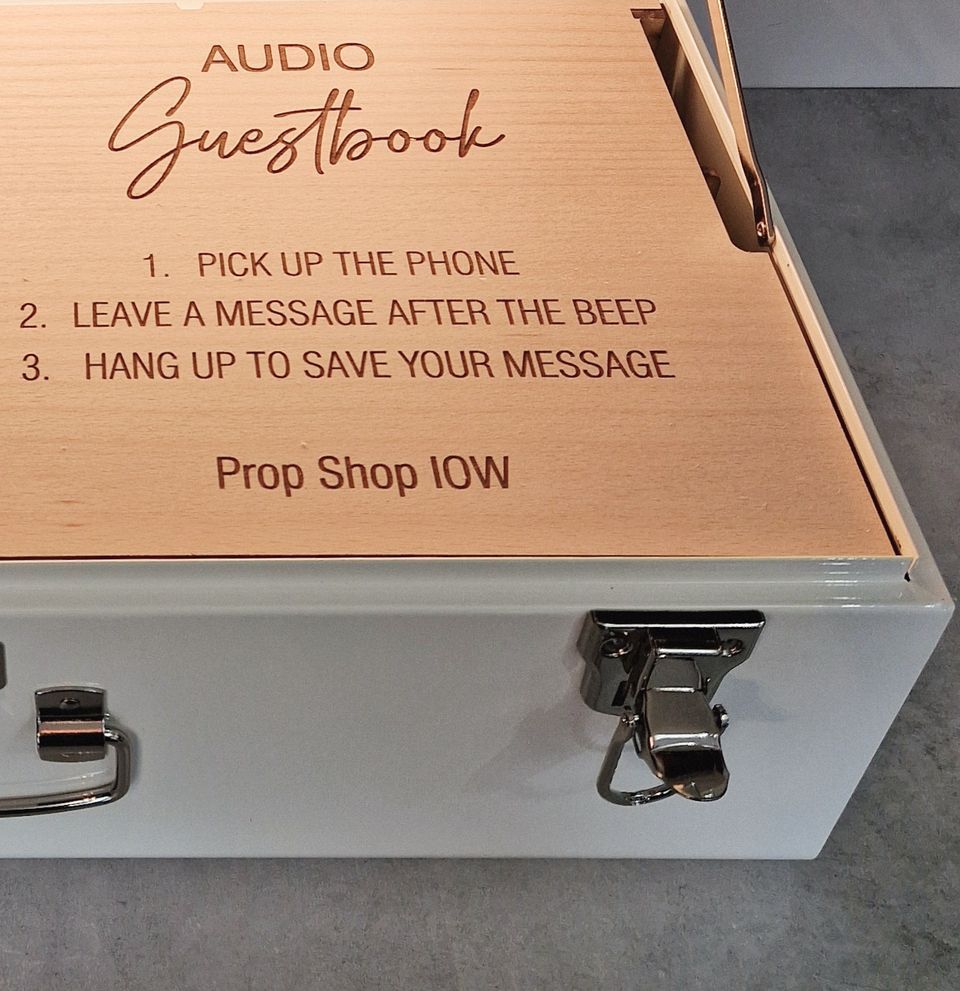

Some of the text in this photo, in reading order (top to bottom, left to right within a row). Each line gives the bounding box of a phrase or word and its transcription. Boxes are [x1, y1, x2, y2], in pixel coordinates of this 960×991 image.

[201, 42, 375, 72] AUDIO
[107, 75, 506, 200] Guestbook
[143, 249, 520, 278] 1. PICK UP THE PHONE
[19, 298, 658, 329] 2. LEAVE A MESSAGE AFTER THE BEEP
[21, 349, 676, 381] 3. HANG UP TO SAVE YOUR MESSAGE
[216, 455, 511, 497] Prop Shop IOW
